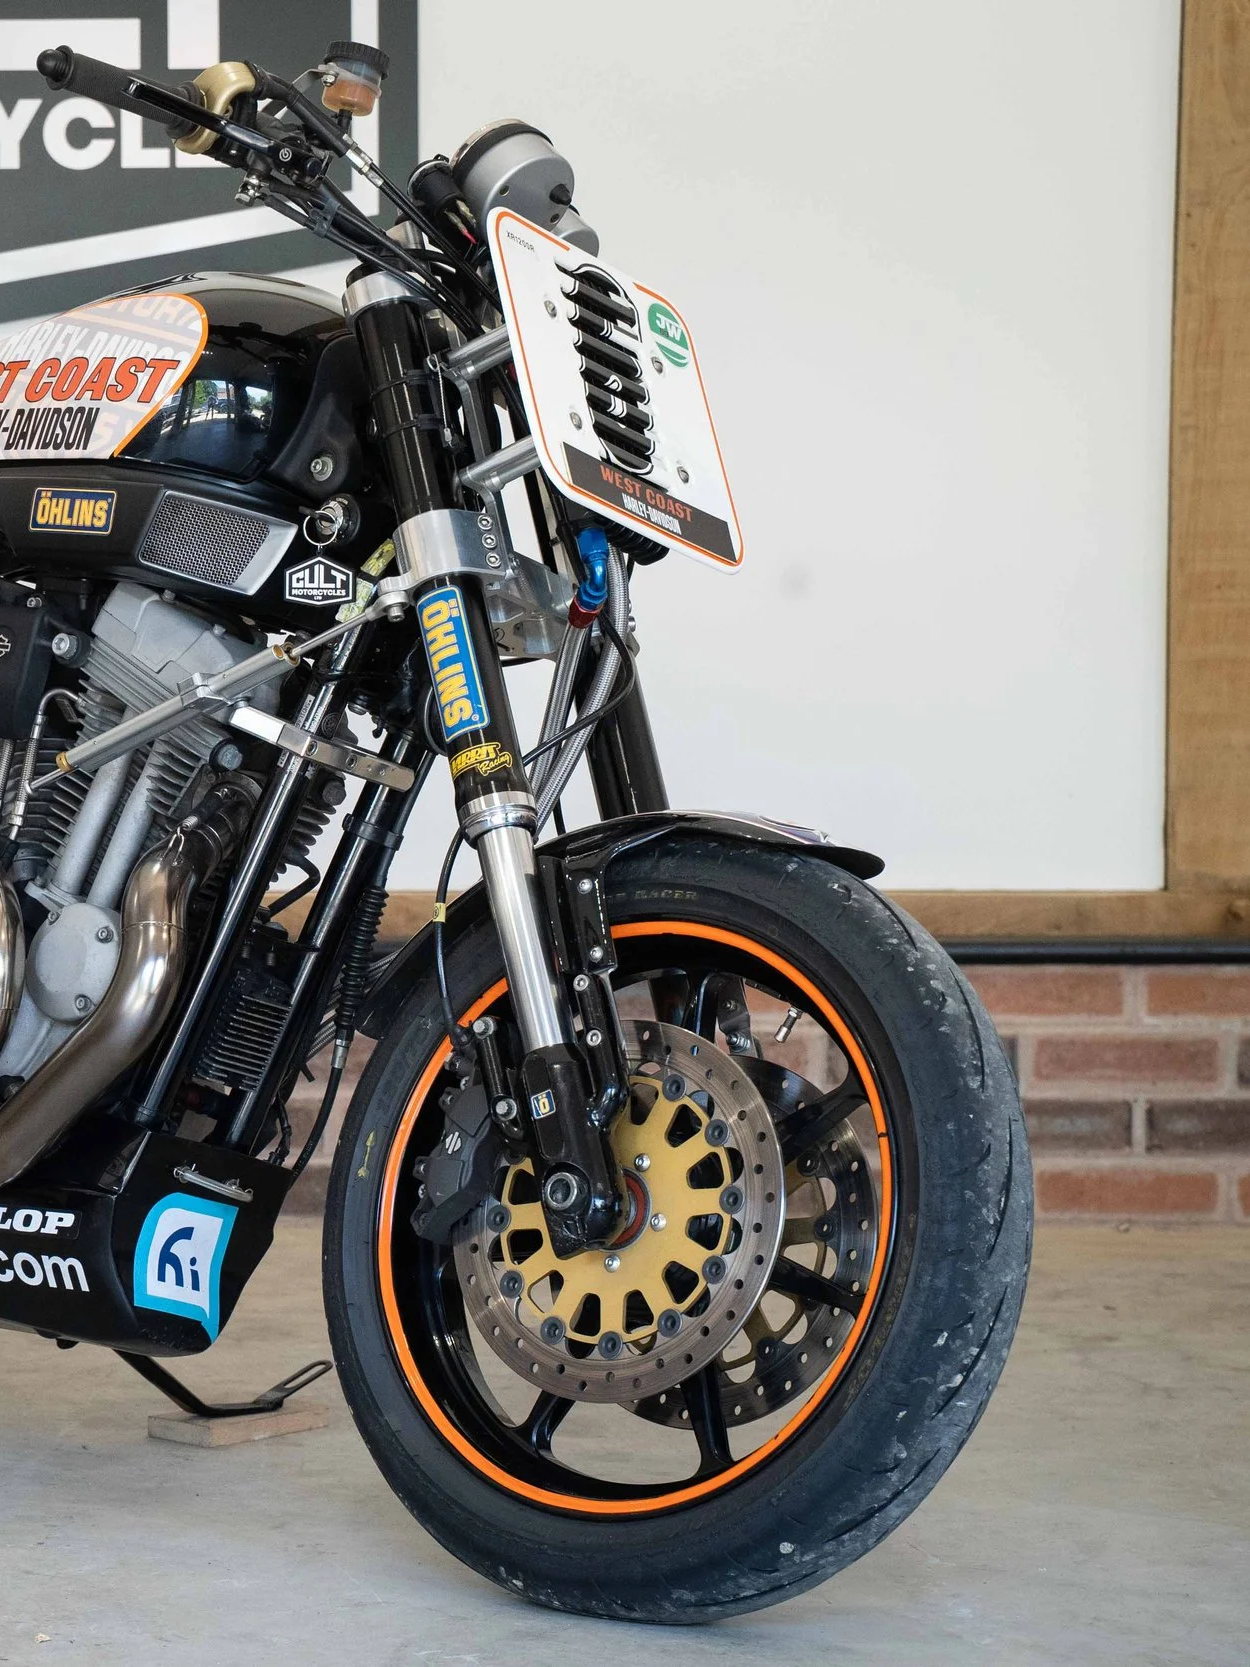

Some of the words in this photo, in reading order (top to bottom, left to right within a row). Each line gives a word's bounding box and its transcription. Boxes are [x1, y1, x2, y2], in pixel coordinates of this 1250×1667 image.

[655, 312, 682, 341] JW
[24, 356, 181, 404] COAST
[35, 490, 109, 528] ÖHLINS
[599, 464, 642, 498] WEST
[645, 488, 693, 522] COAST
[621, 492, 682, 536] HARLEY-DAVIDSON
[291, 563, 347, 589] CULT
[291, 588, 347, 596] MOTORCYCLES
[421, 598, 474, 728] ÖHLINS
[479, 754, 510, 773] Racing
